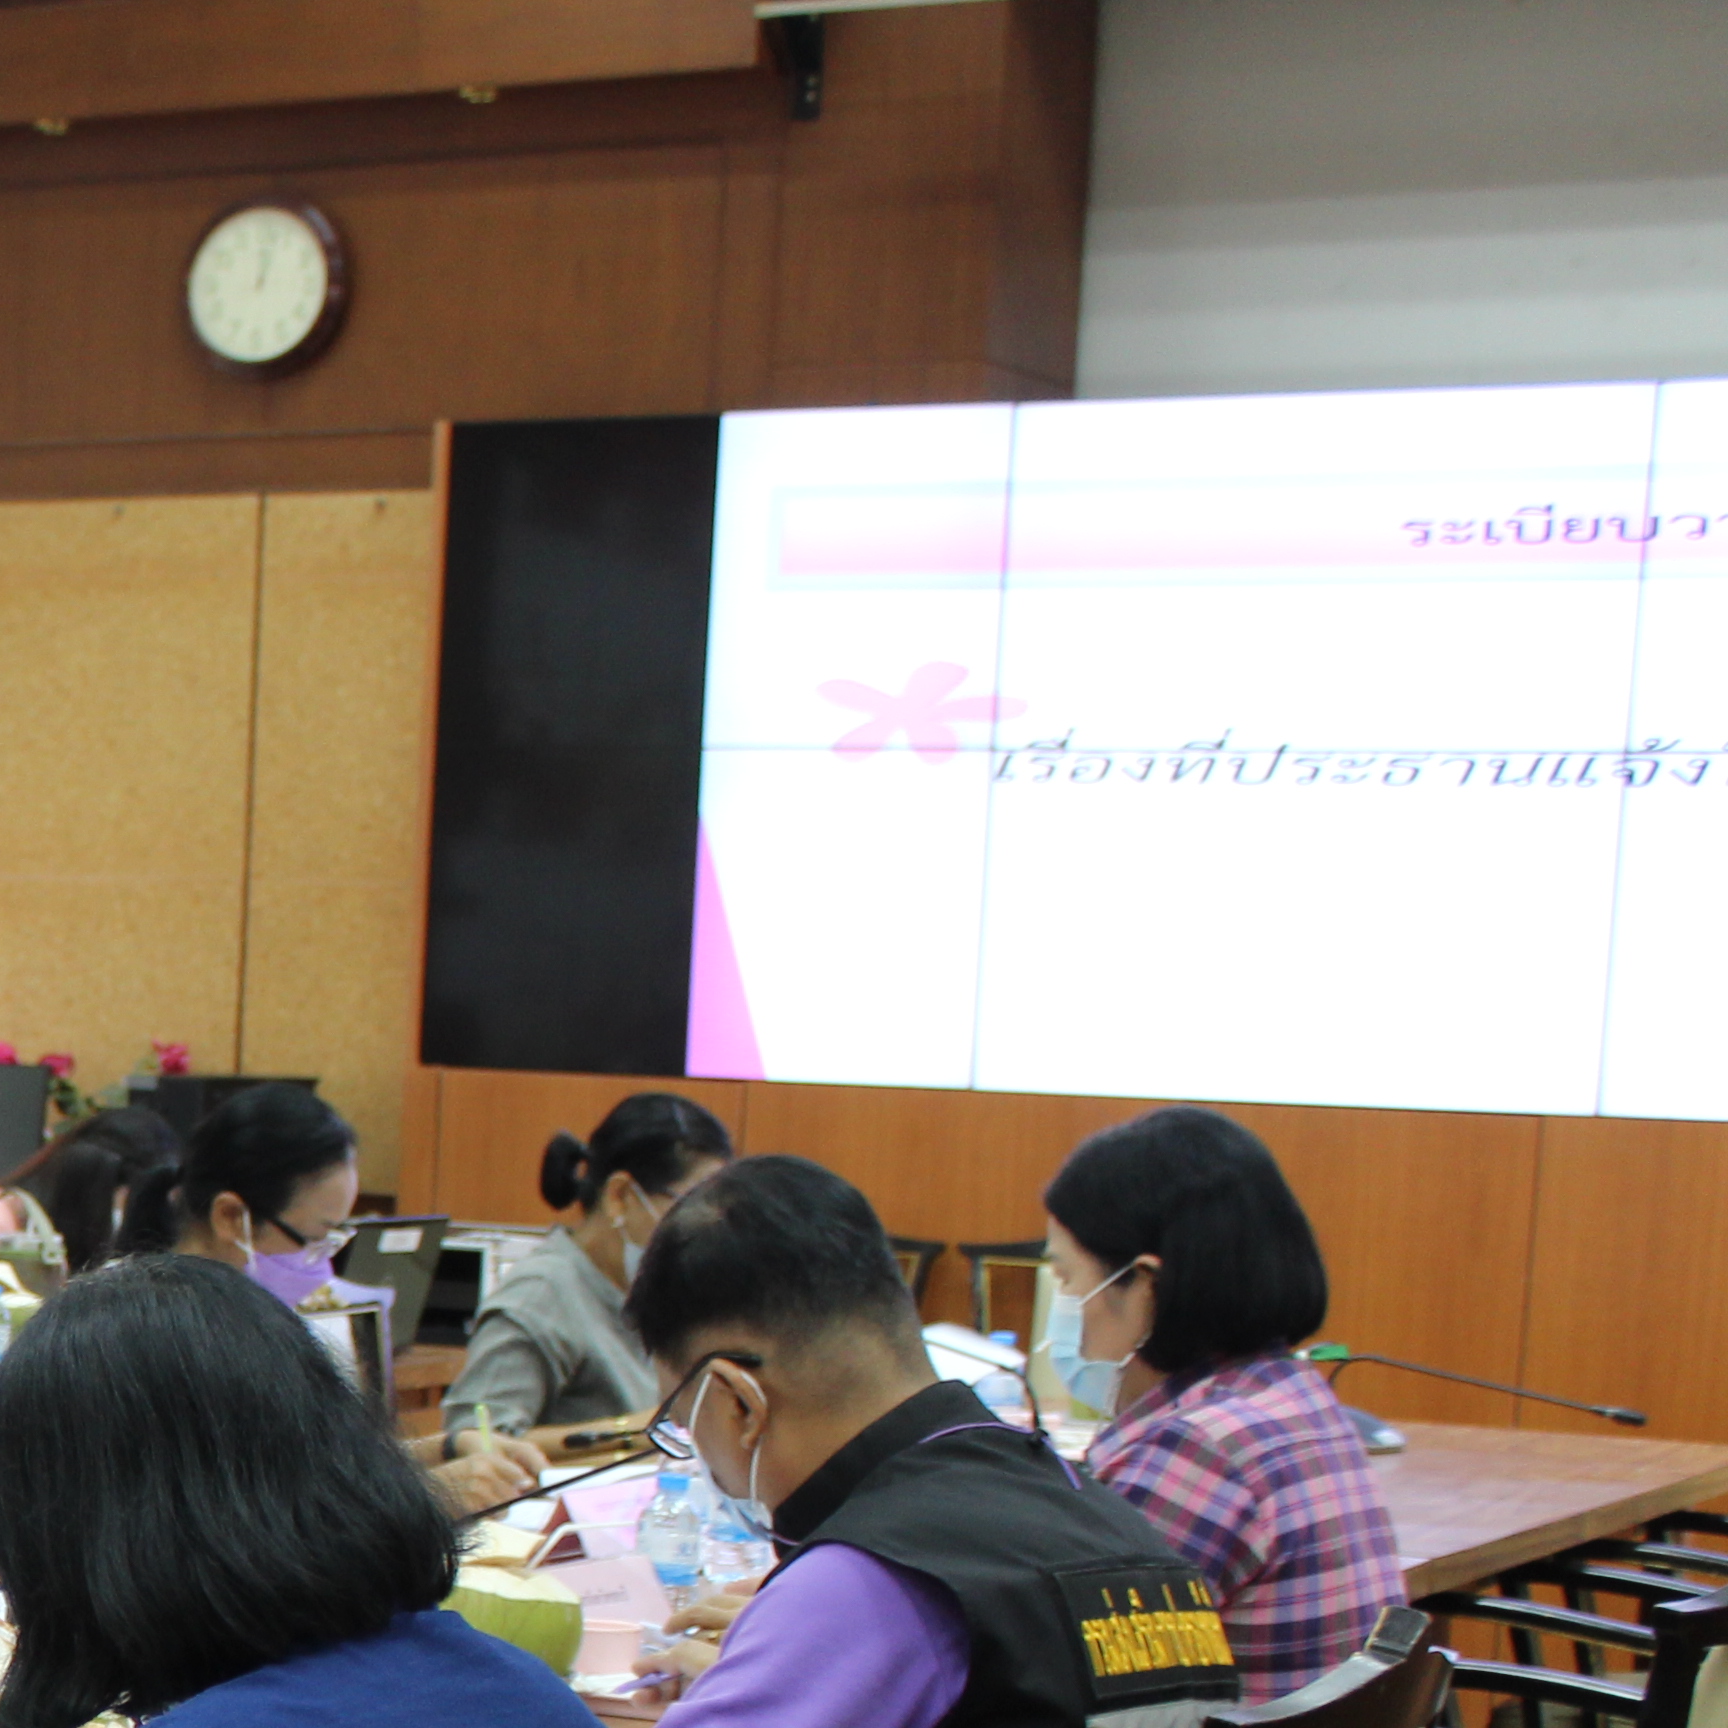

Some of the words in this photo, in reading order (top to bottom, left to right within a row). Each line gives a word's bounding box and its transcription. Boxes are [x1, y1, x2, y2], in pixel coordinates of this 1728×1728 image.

[1401, 503, 1728, 547] ระเบียบว
[992, 727, 1728, 788] เรื่องที่ประธานแจ้ง
